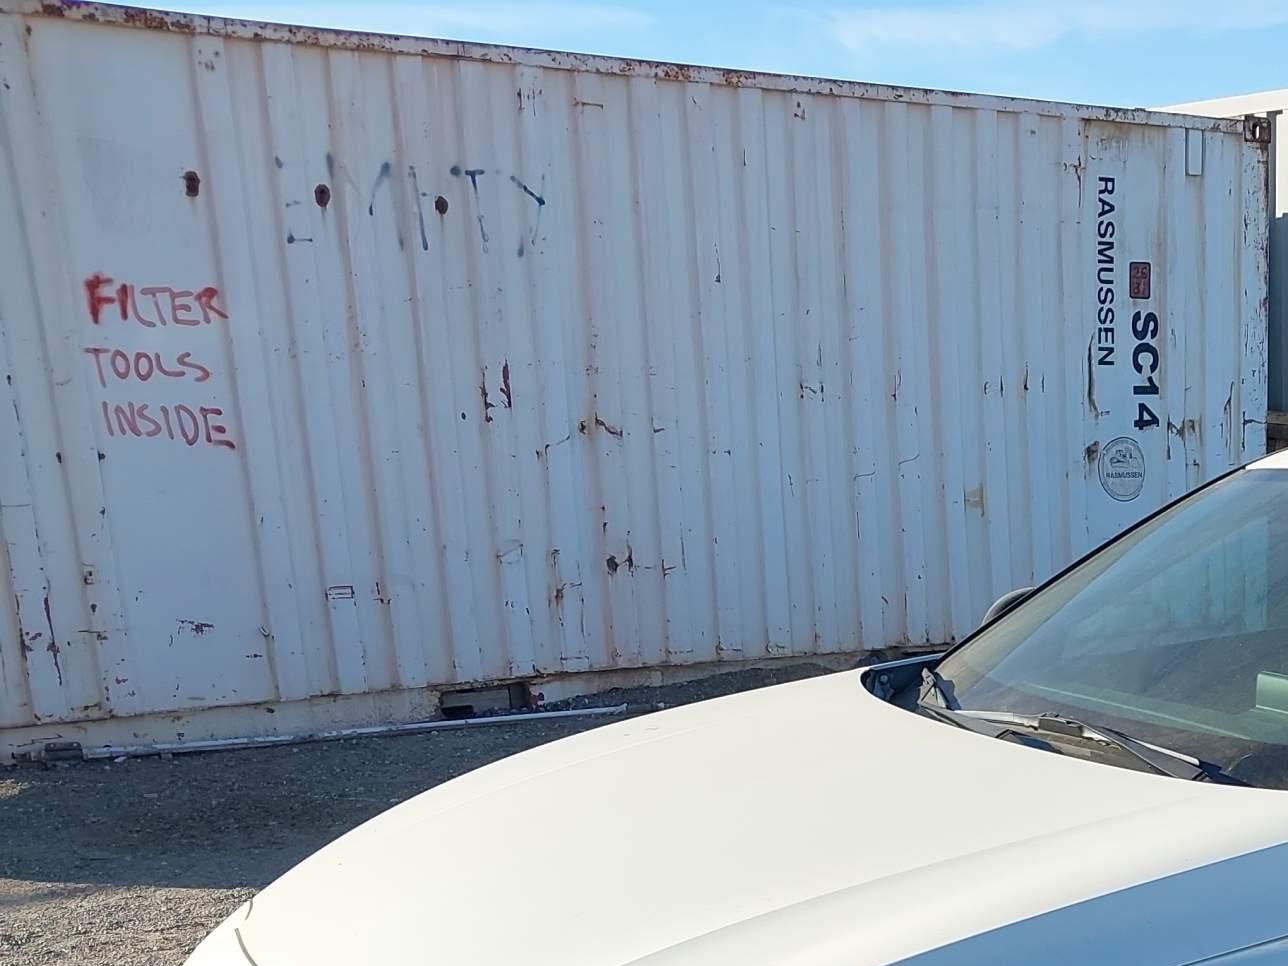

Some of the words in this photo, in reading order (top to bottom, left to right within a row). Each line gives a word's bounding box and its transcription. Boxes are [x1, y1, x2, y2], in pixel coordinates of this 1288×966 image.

[1097, 175, 1116, 367] RASMUSSEN
[84, 272, 228, 328] FILTER
[84, 346, 210, 388] TOOLS
[1131, 310, 1160, 431] SC14
[102, 400, 236, 450] INSIDE
